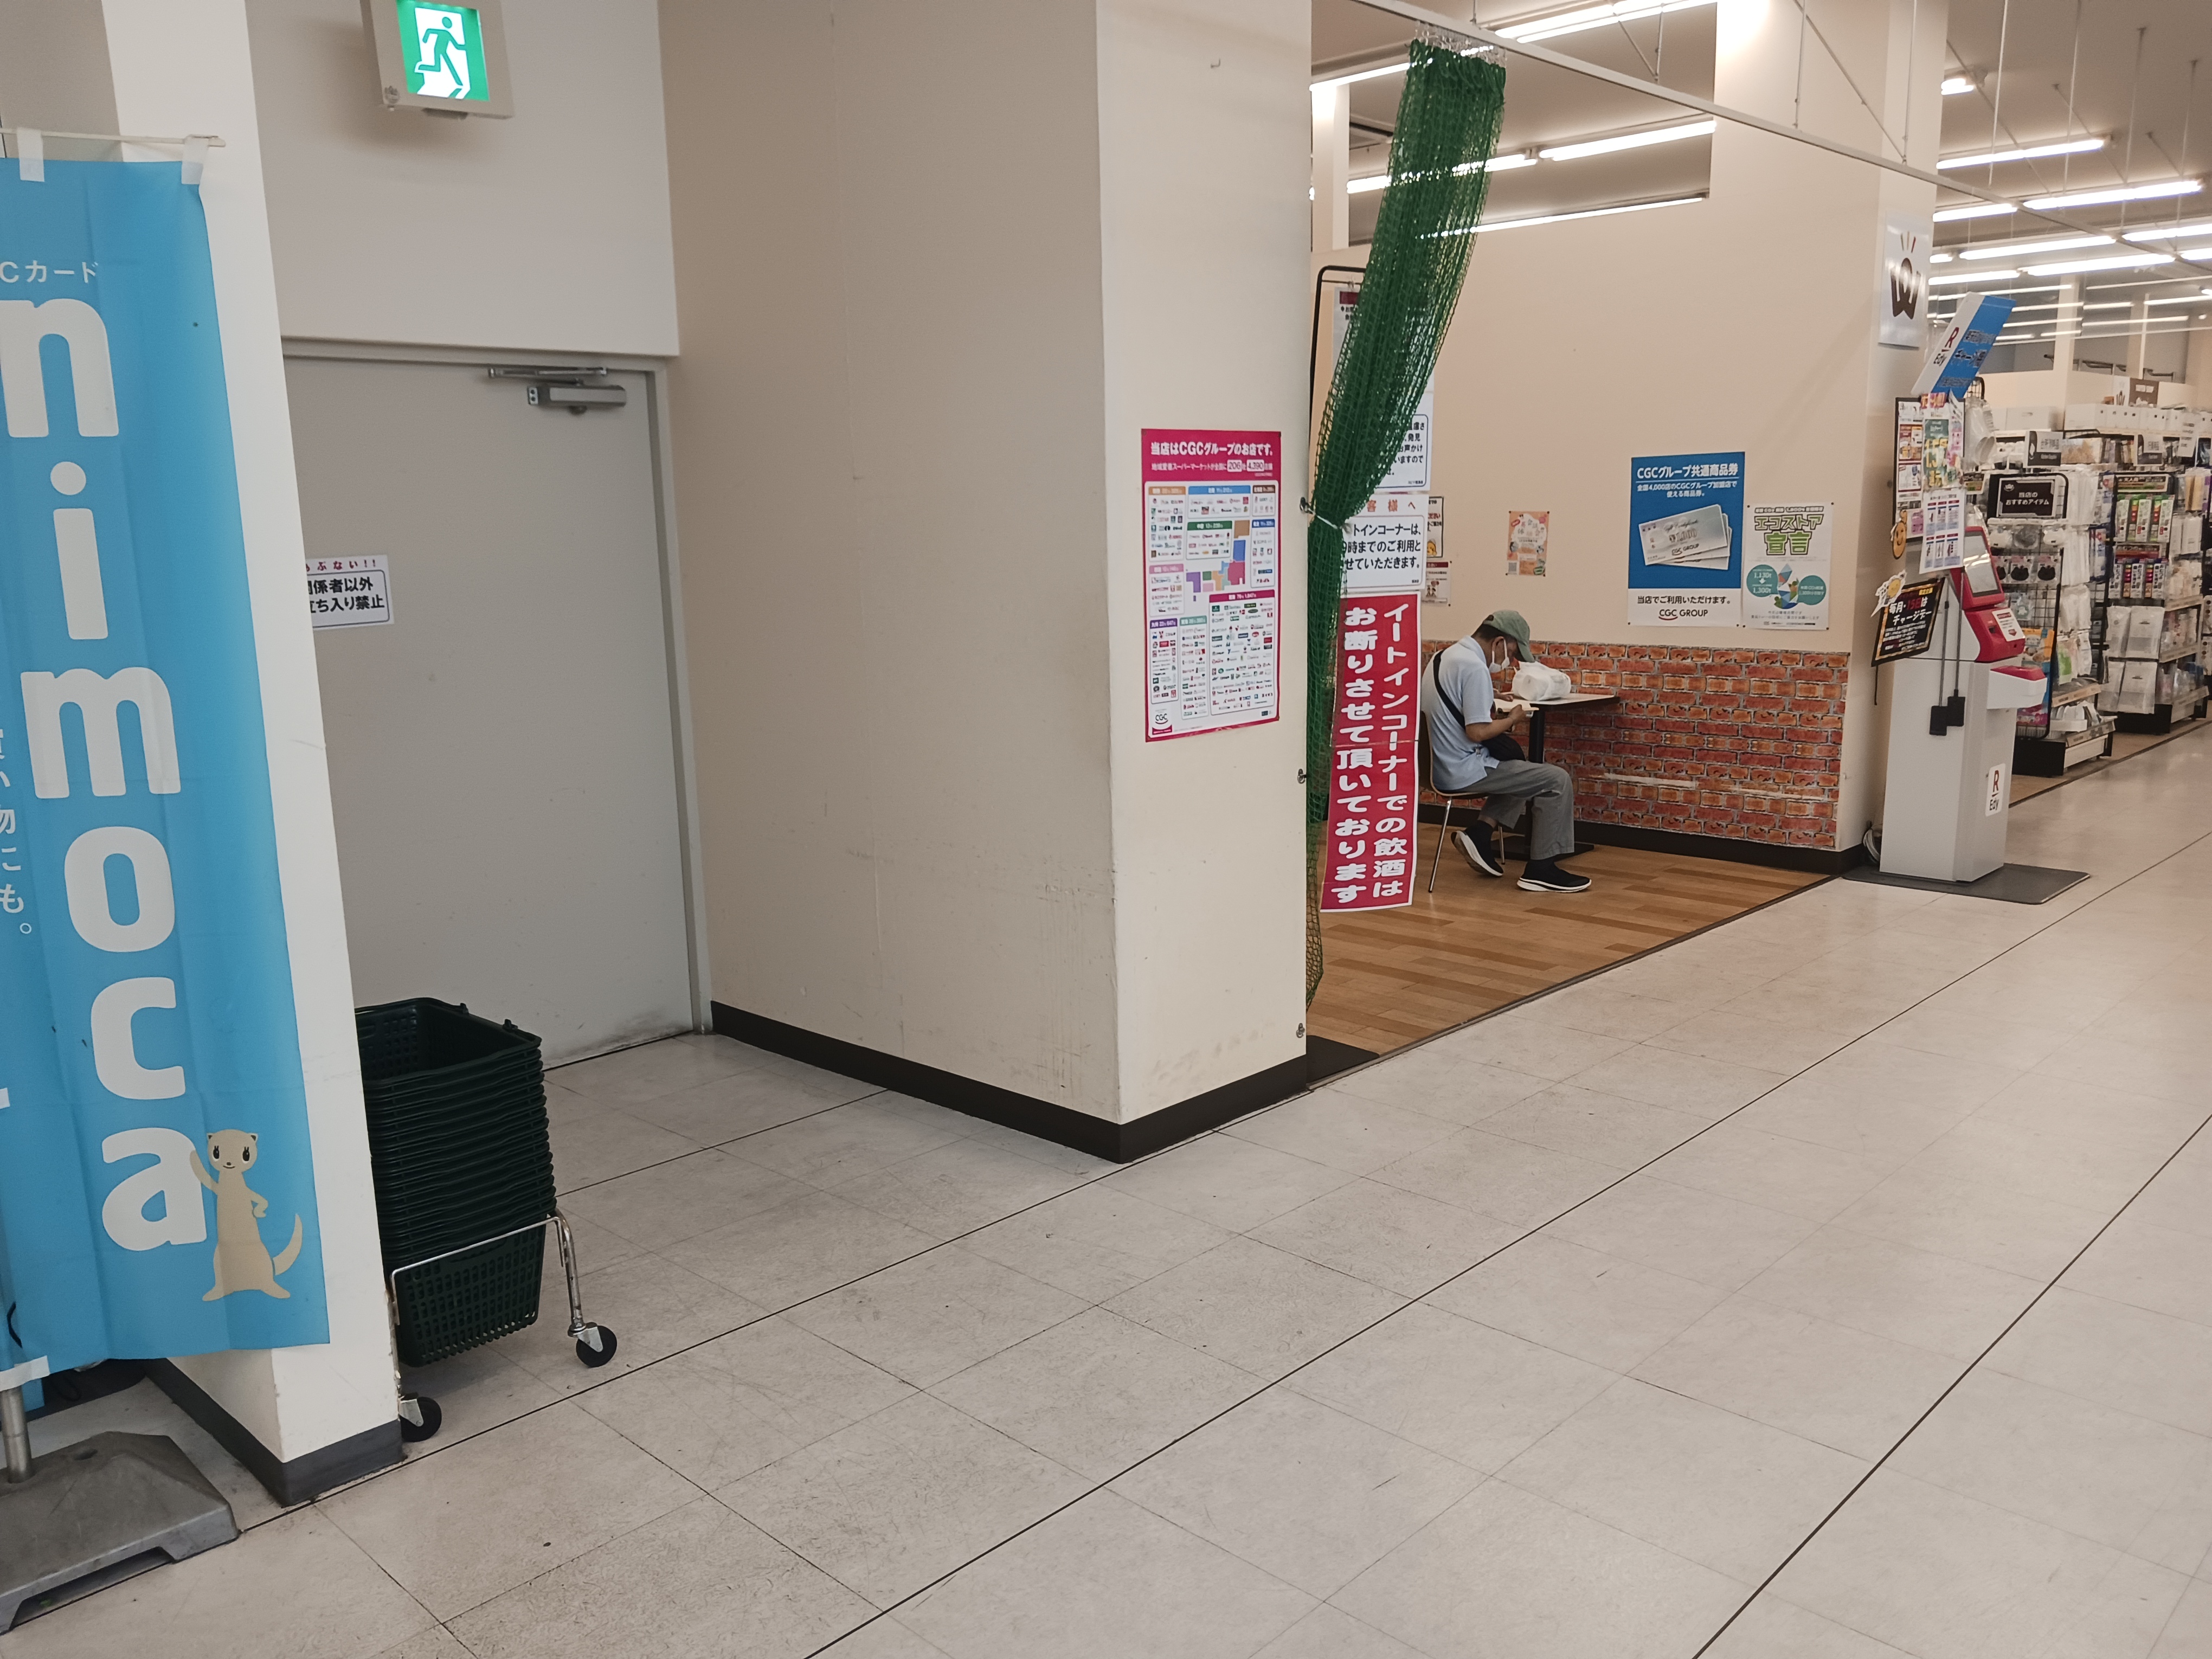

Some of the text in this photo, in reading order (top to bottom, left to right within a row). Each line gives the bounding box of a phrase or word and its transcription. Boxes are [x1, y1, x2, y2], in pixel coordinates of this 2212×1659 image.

[1933, 353, 1947, 367] Edy
[1637, 462, 1738, 479] CGCグループ共通商品券
[1754, 514, 1824, 531] エコストア
[1764, 530, 1812, 555] 宣言
[1637, 596, 1731, 605] 当店でご利用いただけます。
[1659, 609, 1708, 617] CGC GROUP
[1331, 607, 1378, 903] お断りさせて頂いております
[1372, 603, 1409, 898] イートインコーナーでの飲酒は
[0, 298, 207, 1251] nimoca
[1989, 798, 1999, 811] Edy
